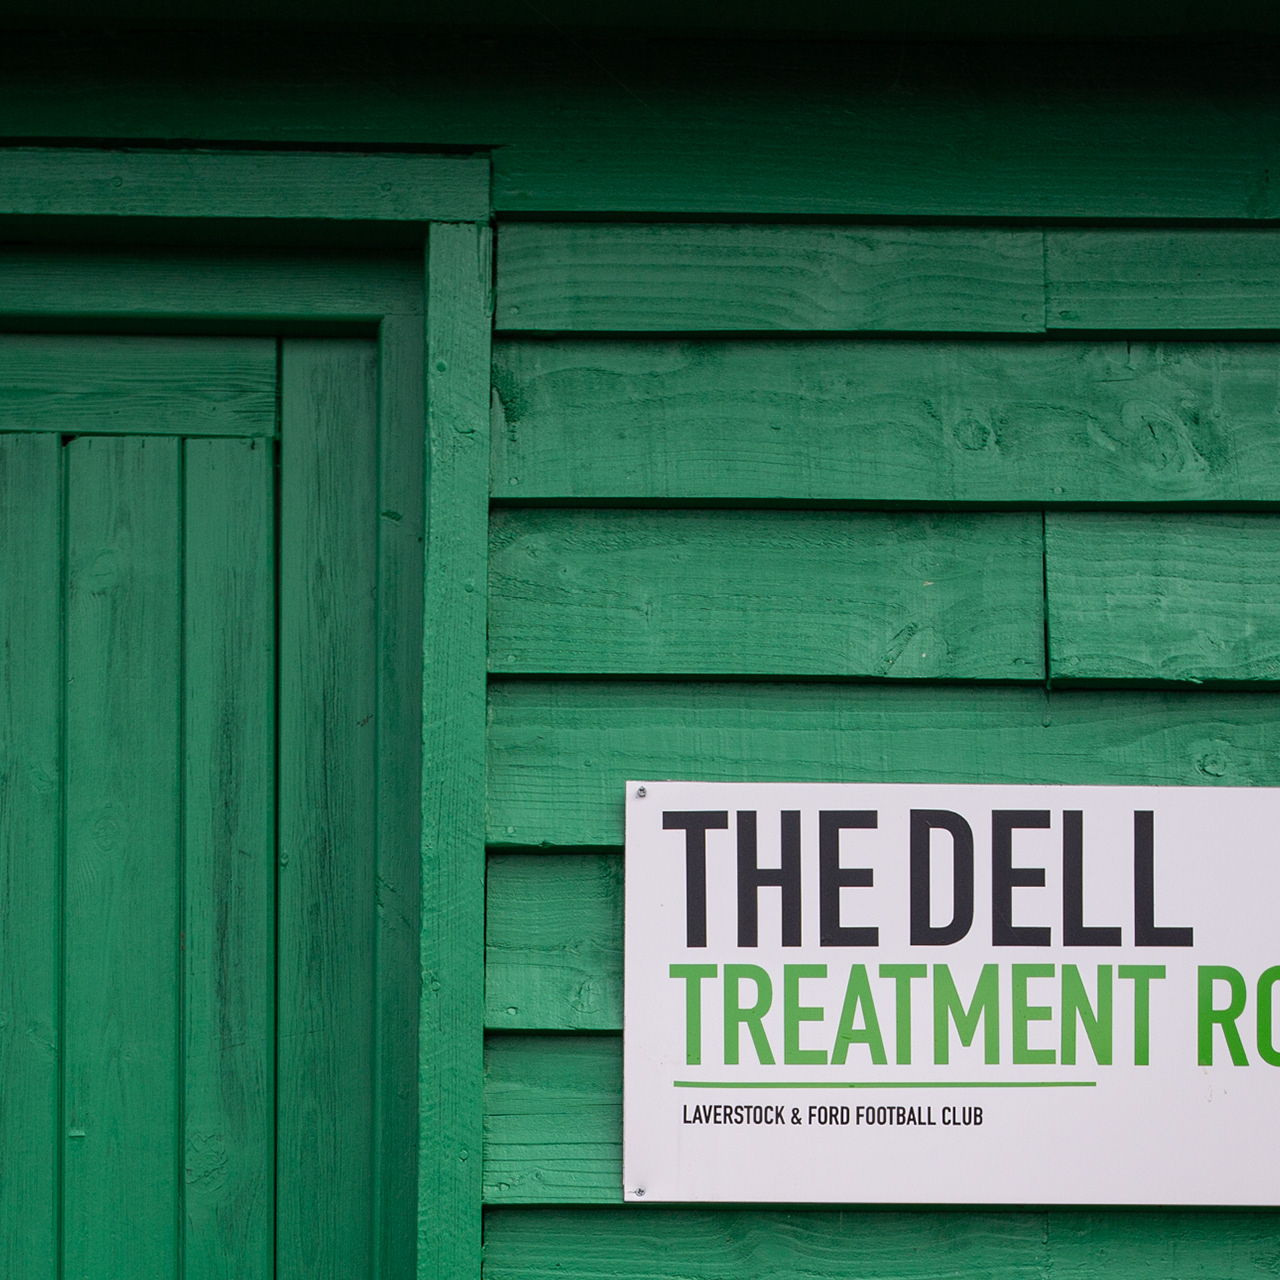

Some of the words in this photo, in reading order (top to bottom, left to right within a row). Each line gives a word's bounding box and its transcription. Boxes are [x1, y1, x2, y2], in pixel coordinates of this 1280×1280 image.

[662, 809, 880, 948] THE
[909, 808, 1194, 948] DELL
[669, 963, 1167, 1066] TREATMENT
[683, 1104, 786, 1125] LAVERSTOCK
[790, 1107, 802, 1125] &
[808, 1105, 850, 1126] FORD
[856, 1106, 937, 1126] FOOTBALL
[941, 1106, 983, 1126] CLUB
